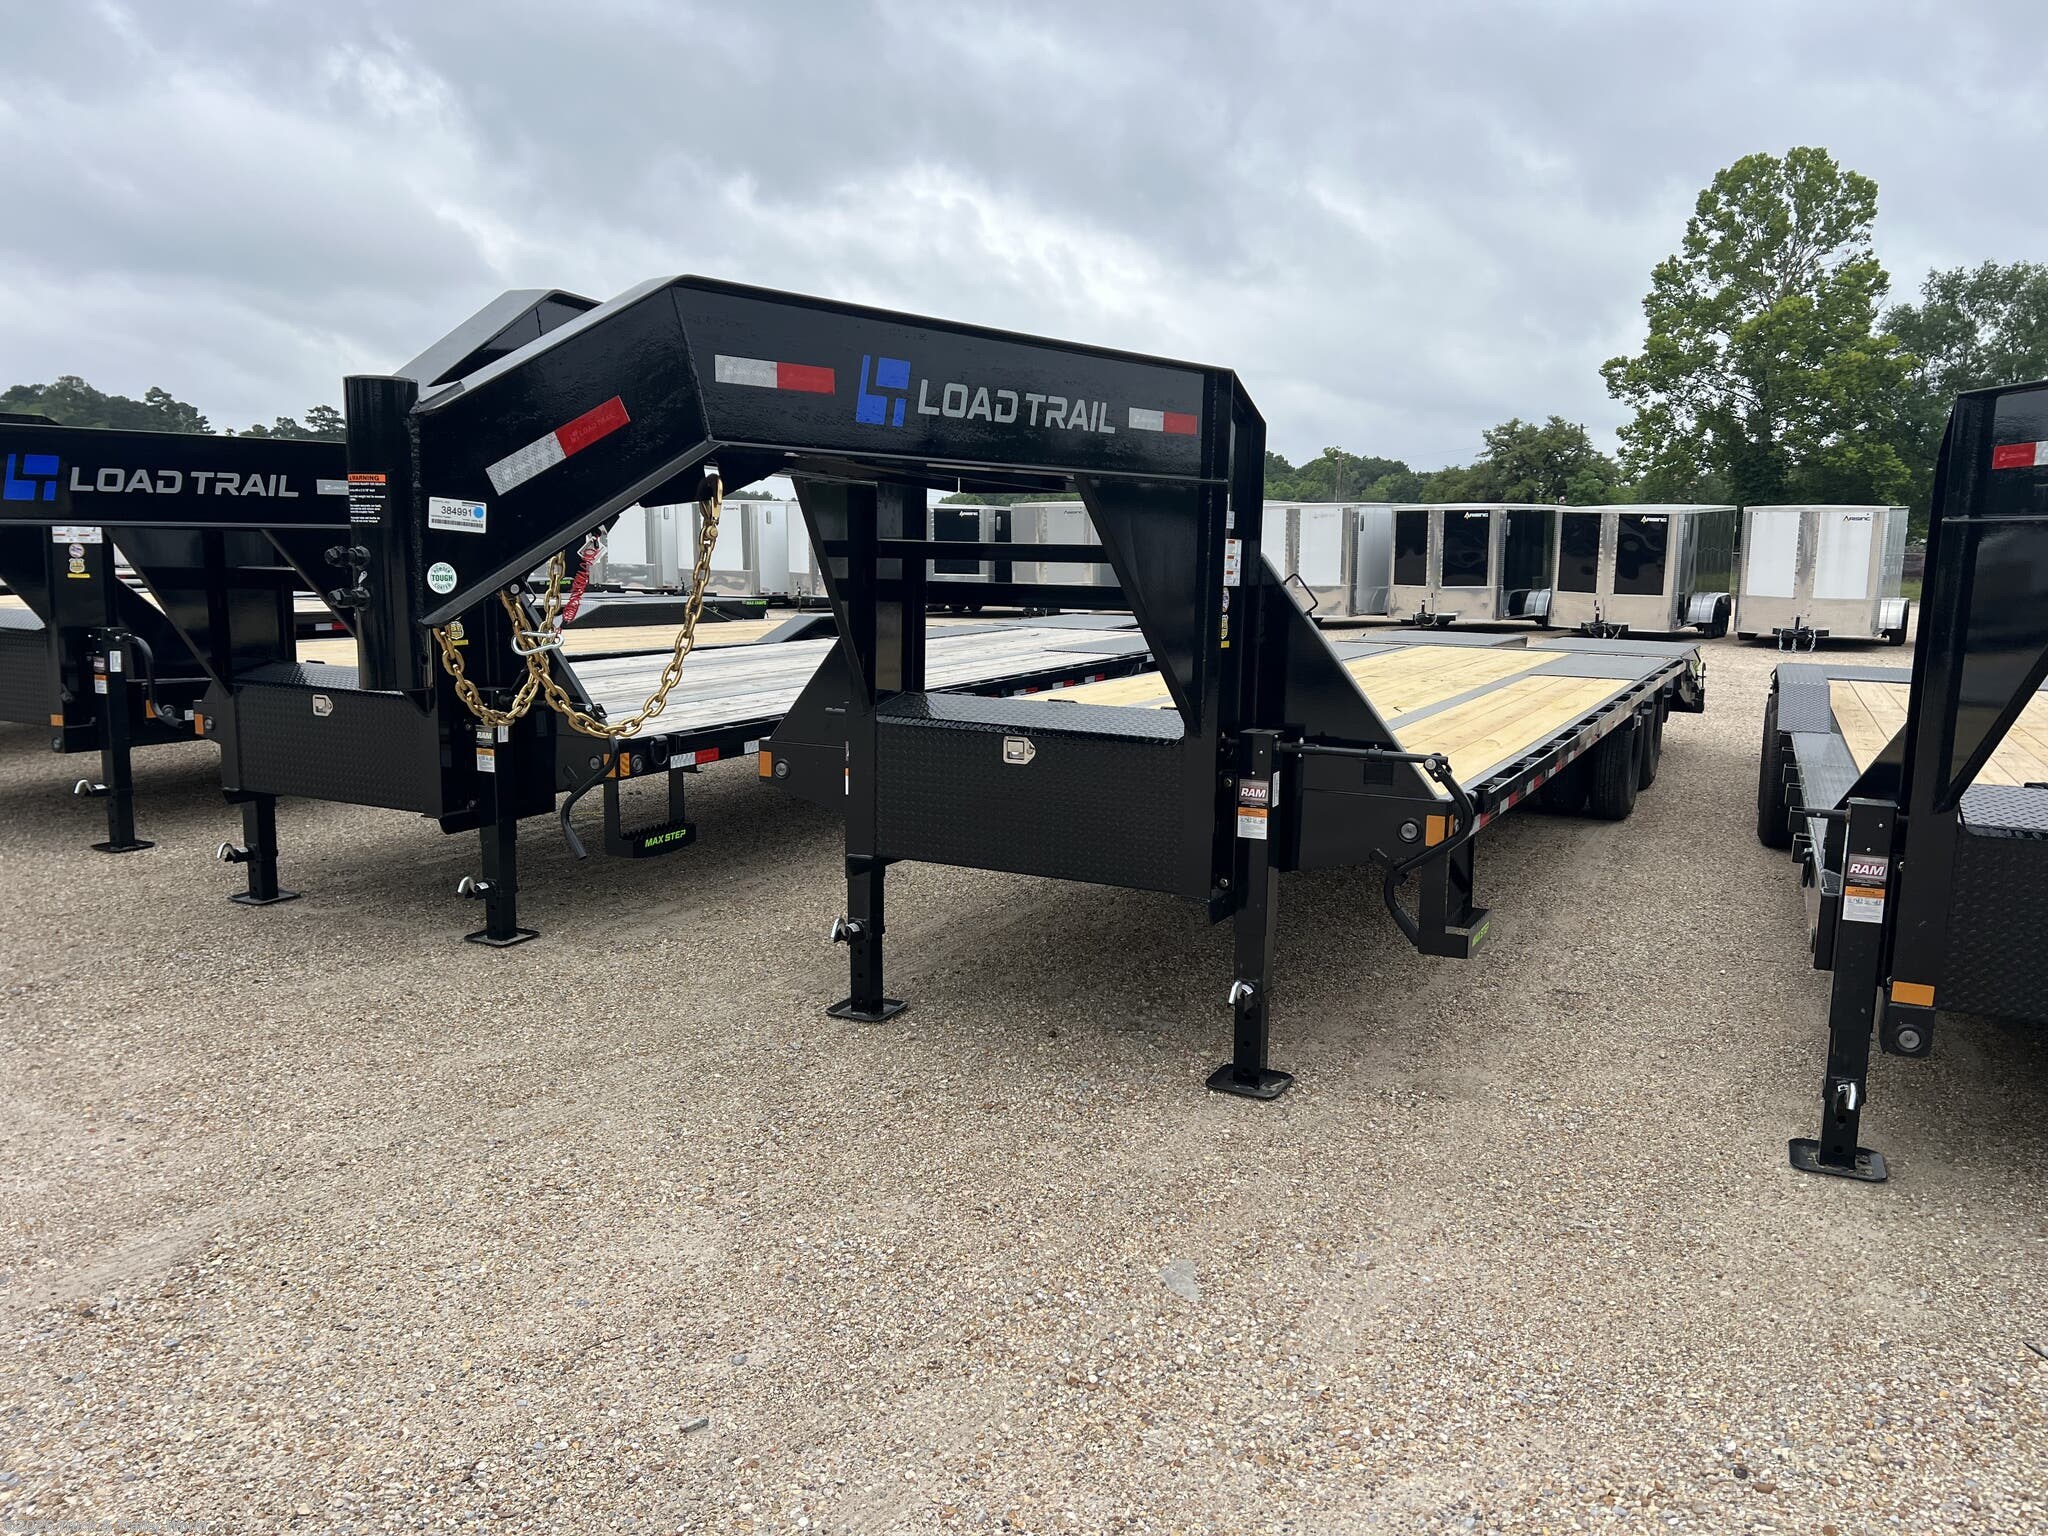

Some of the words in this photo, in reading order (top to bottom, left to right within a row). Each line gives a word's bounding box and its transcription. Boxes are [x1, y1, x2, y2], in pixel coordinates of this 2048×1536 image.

[917, 379, 1018, 424] LOAD
[1025, 392, 1116, 434] TRAIL
[69, 466, 183, 494] LOAD
[190, 471, 299, 498] TRAIL
[441, 505, 472, 517] 384991
[1241, 787, 1266, 798] RAM
[645, 835, 664, 848] MAX
[664, 829, 687, 842] STEP
[1849, 863, 1885, 876] RAM
